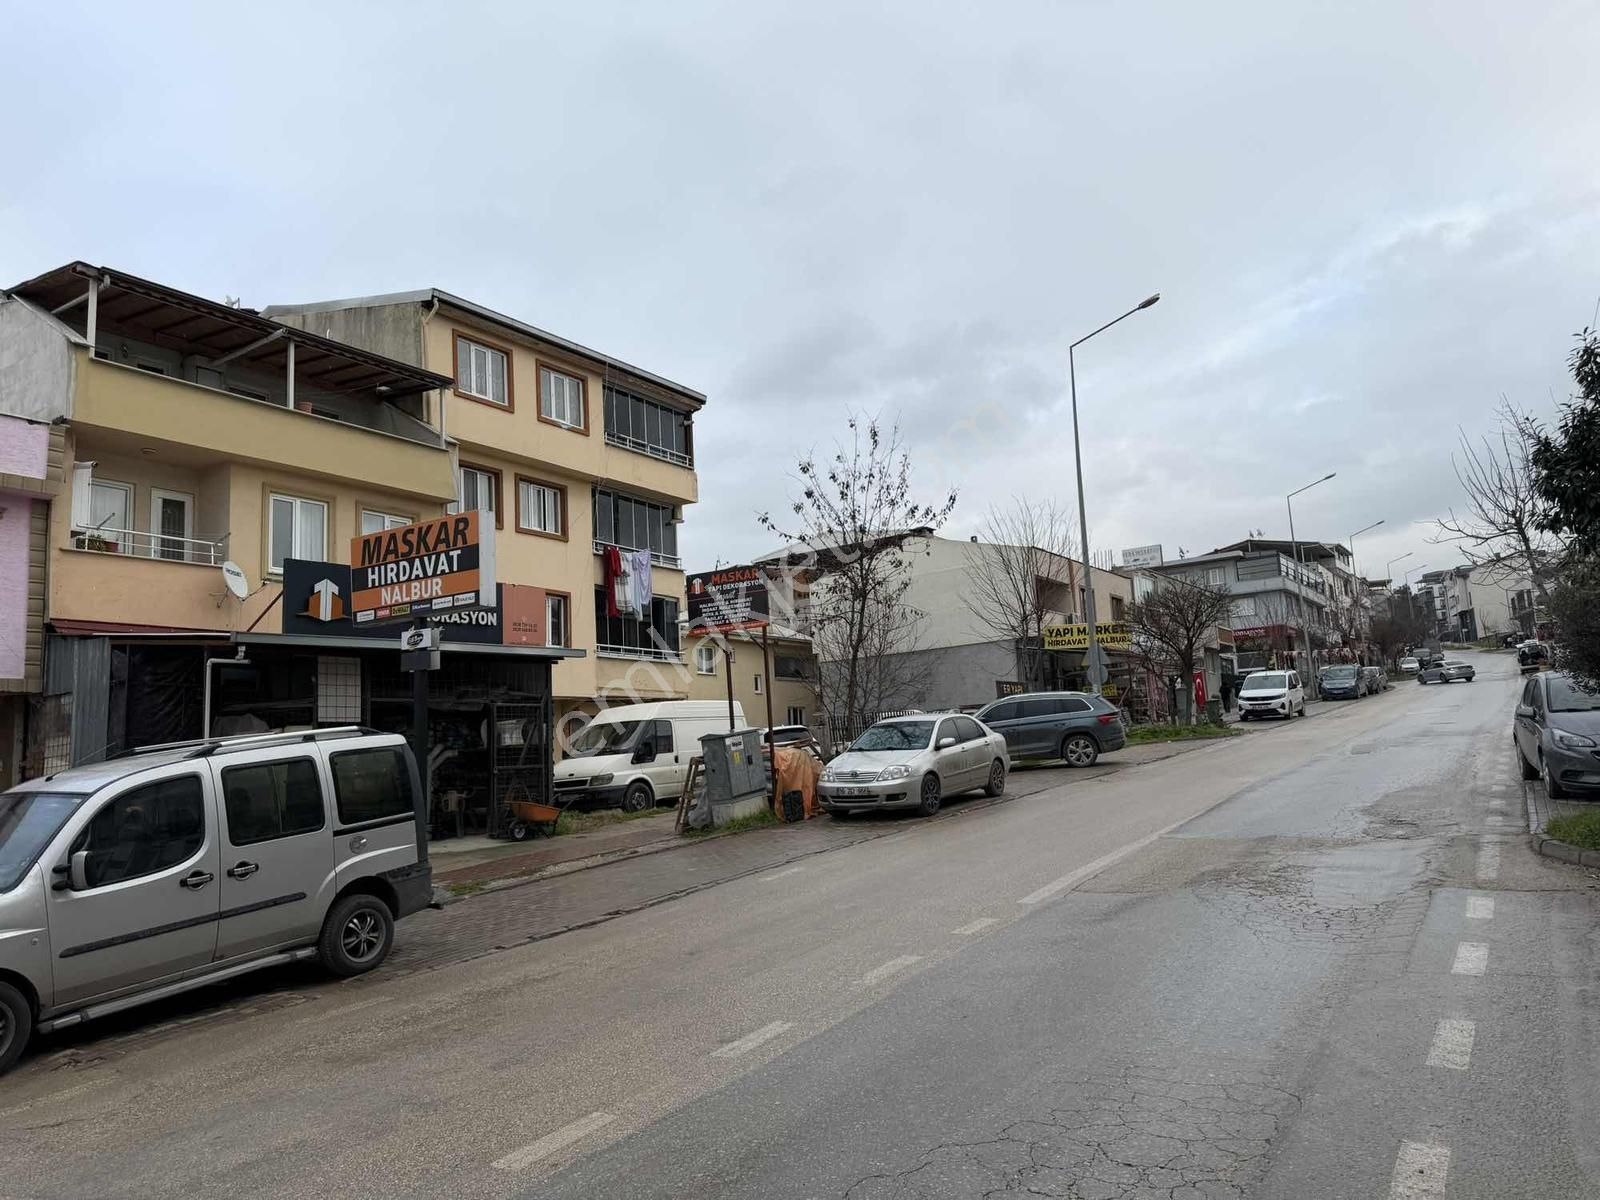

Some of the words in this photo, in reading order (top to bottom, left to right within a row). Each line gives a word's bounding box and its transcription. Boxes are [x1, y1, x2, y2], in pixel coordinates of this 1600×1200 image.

[361, 517, 470, 567] MASKAR
[368, 549, 462, 588] HIRDAVAT
[712, 568, 759, 585] MASKAR
[381, 577, 443, 606] NALBUR
[427, 611, 497, 626] ORASYON
[1048, 627, 1073, 638] YAPI
[1077, 624, 1126, 637] MRKET
[1048, 638, 1087, 647] HIRDAVAT
